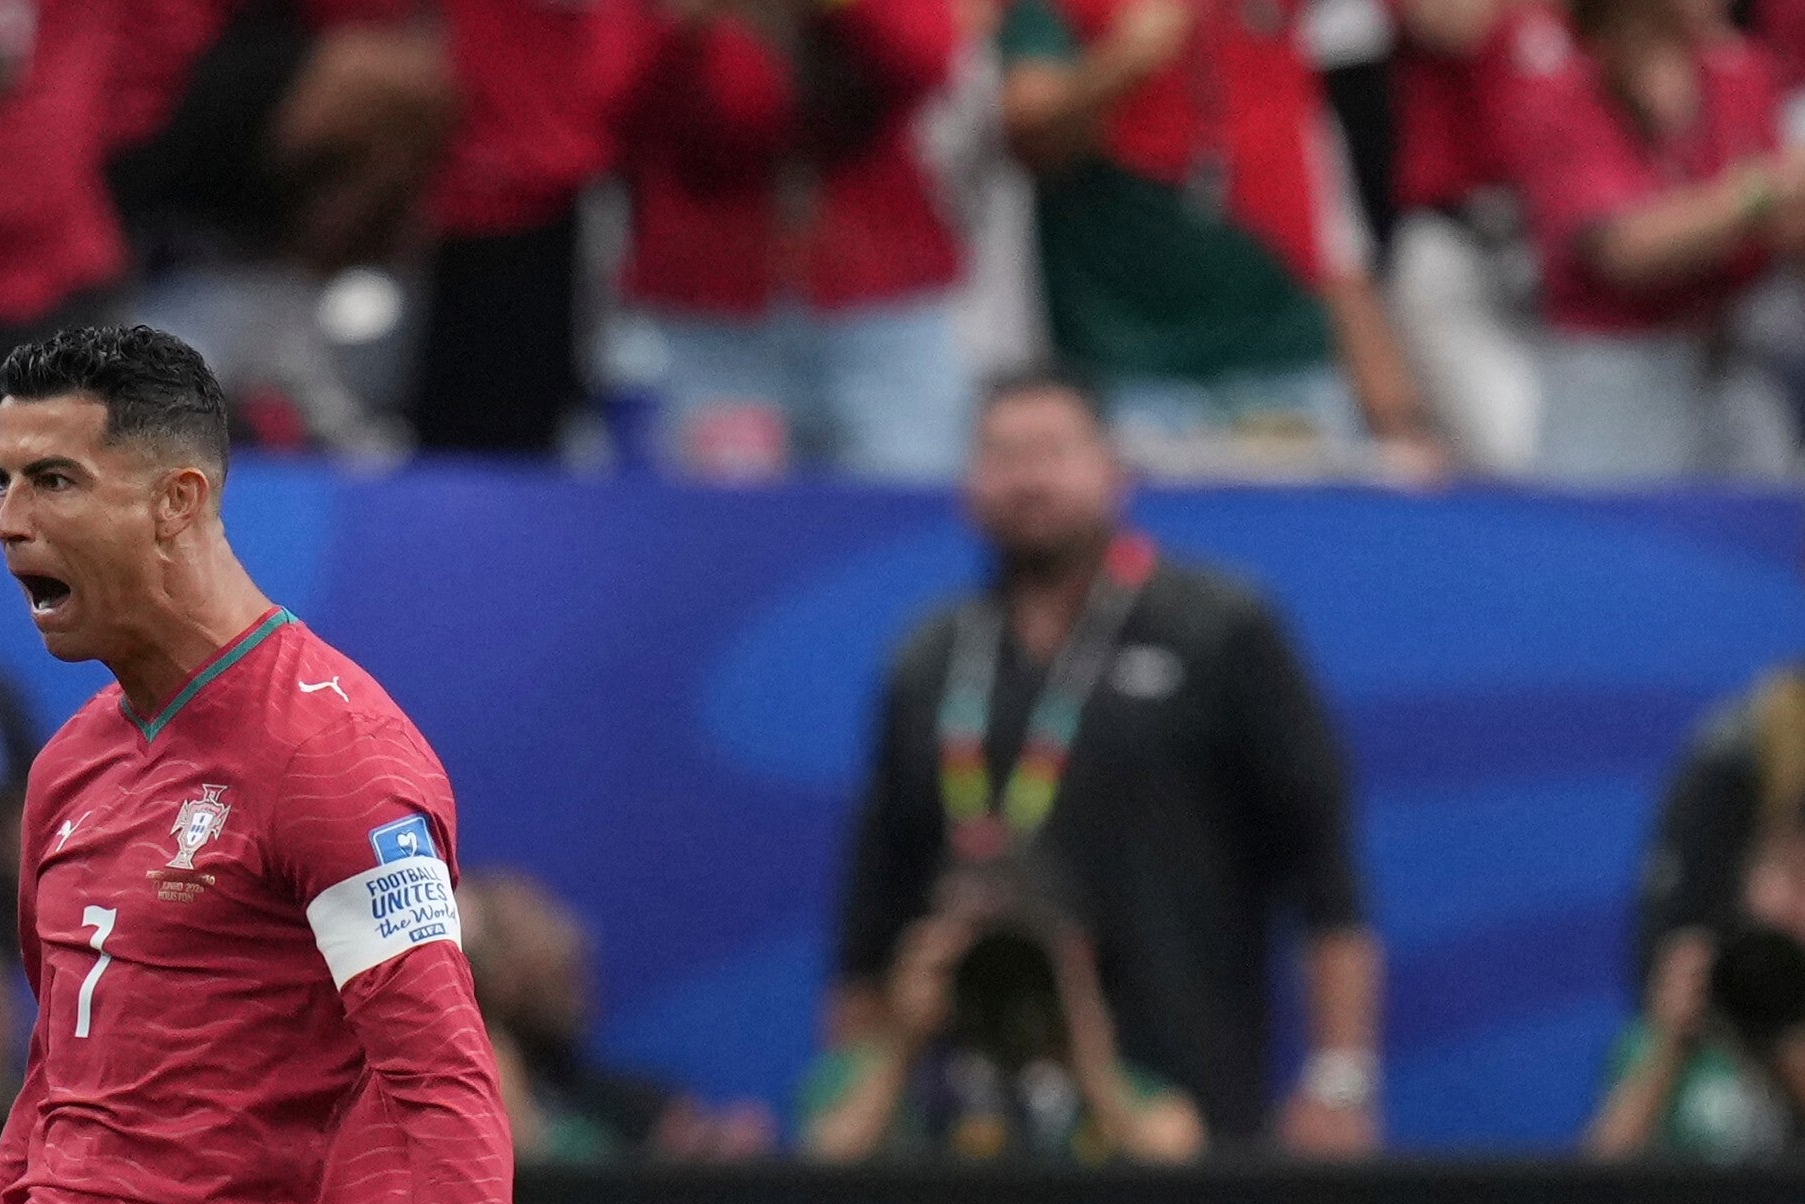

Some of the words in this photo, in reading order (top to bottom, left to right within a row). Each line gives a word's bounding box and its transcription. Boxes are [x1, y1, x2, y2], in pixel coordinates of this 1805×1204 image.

[366, 867, 441, 896] FOOTBALL
[372, 882, 447, 919] UNITES
[375, 918, 411, 938] the
[409, 903, 457, 924] World
[410, 923, 446, 942] FIFA
[75, 905, 117, 1038] 7
